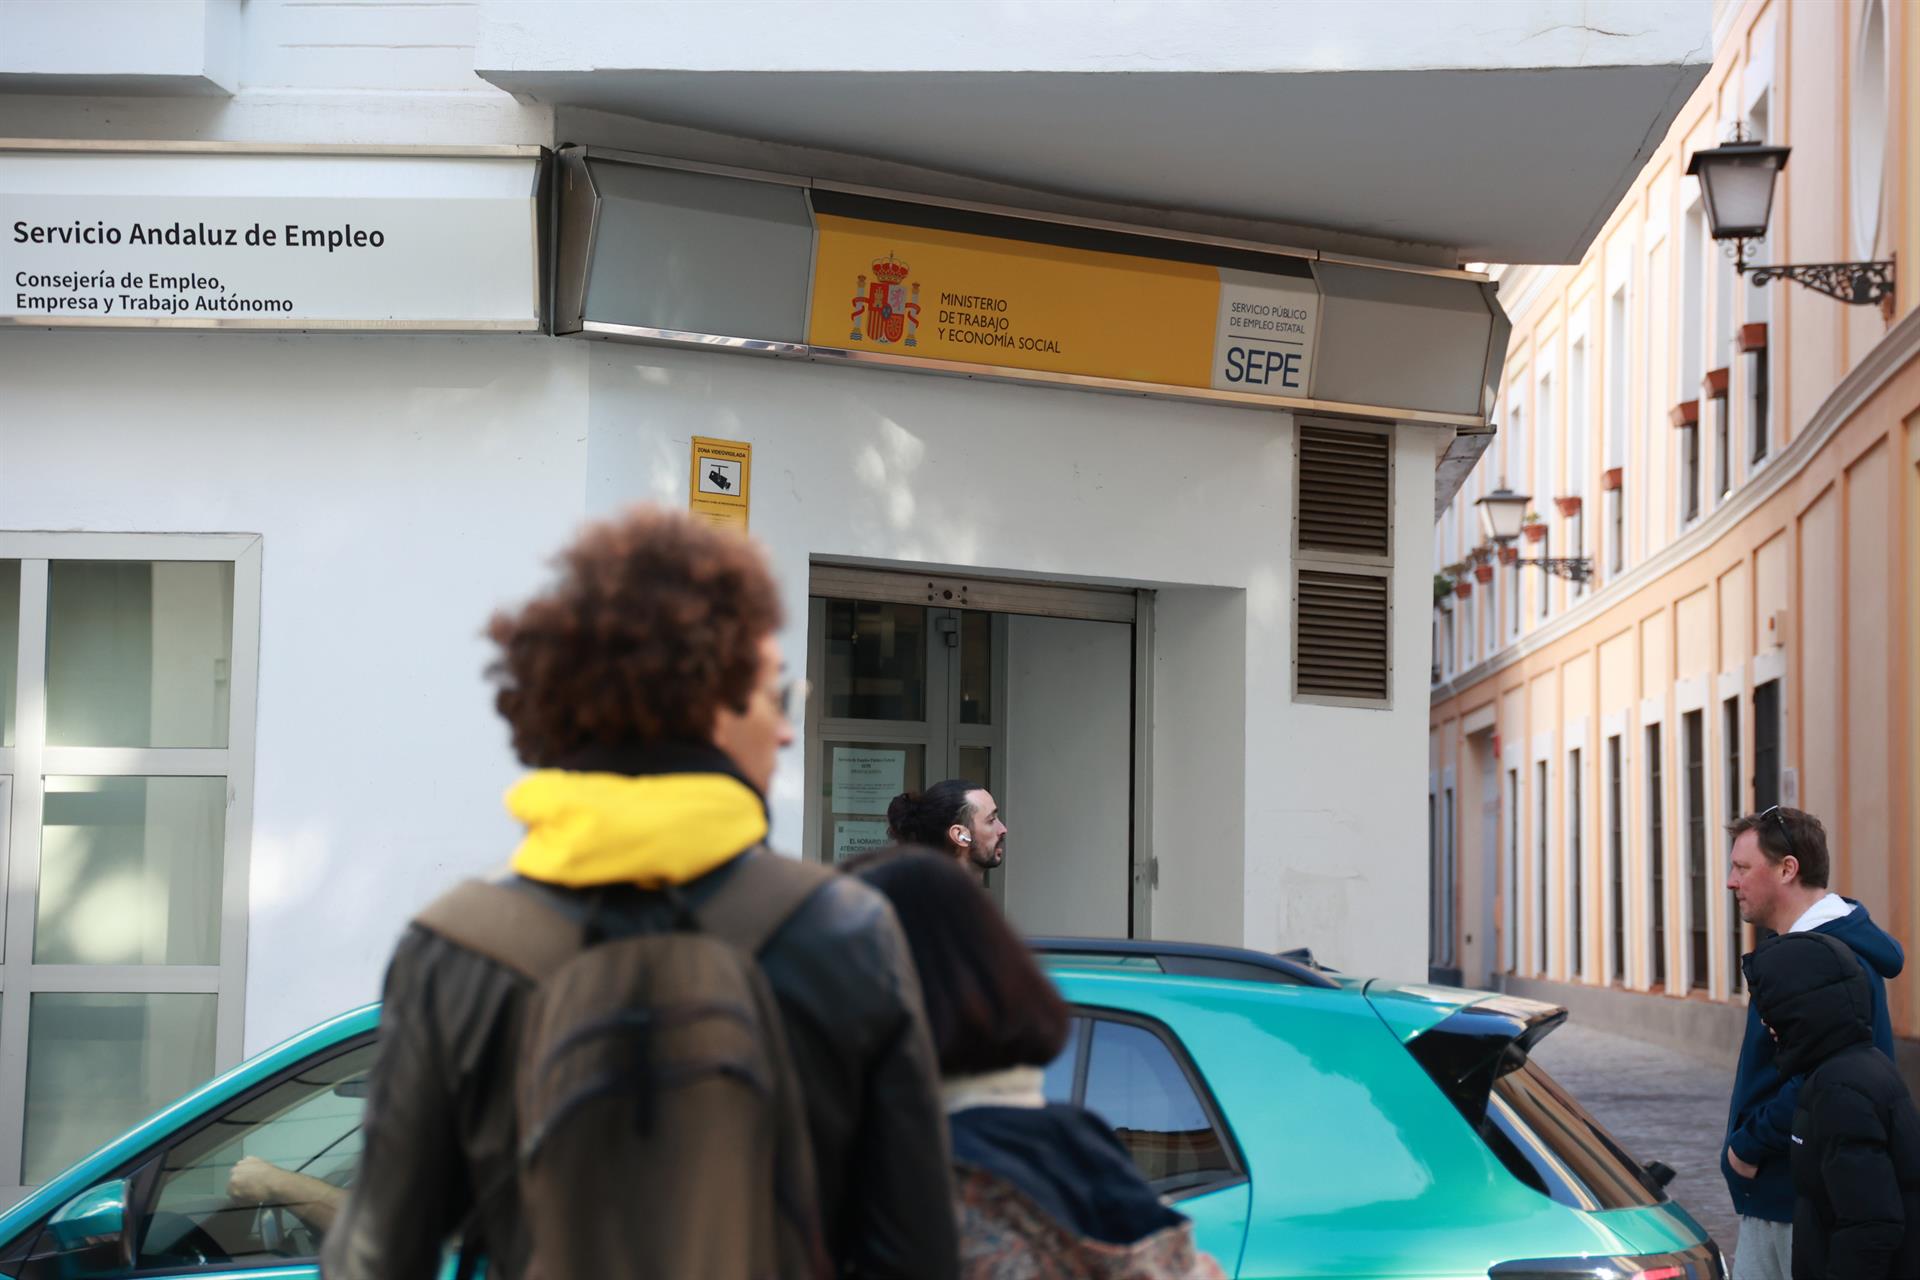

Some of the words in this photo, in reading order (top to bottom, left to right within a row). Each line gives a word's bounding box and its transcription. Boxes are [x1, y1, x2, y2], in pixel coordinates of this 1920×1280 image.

[13, 221, 122, 244] Servicio
[129, 222, 238, 246] Andaluz
[245, 223, 277, 247] de
[285, 224, 385, 252] Empleo
[15, 270, 115, 292] Consejería
[121, 272, 143, 288] de
[149, 273, 226, 293] Empleo,
[16, 293, 99, 312] Empresa
[103, 298, 114, 314] y
[118, 294, 189, 315] Trabajo
[195, 292, 294, 312] Autónomo
[940, 292, 1008, 313] MINISTERIO
[1231, 302, 1270, 316] SERVICIO
[1272, 305, 1307, 320] PÚBLICO
[939, 310, 956, 324] DE
[956, 312, 1009, 331] TRABAJO
[1230, 316, 1242, 327] DE
[1243, 318, 1274, 331] EMPLEO
[1275, 322, 1305, 334] ESTATAL
[937, 327, 946, 341] Y
[948, 328, 1016, 349] ECONOMÍA
[1018, 337, 1062, 354] SOCIAL
[1225, 346, 1302, 388] SEPE
